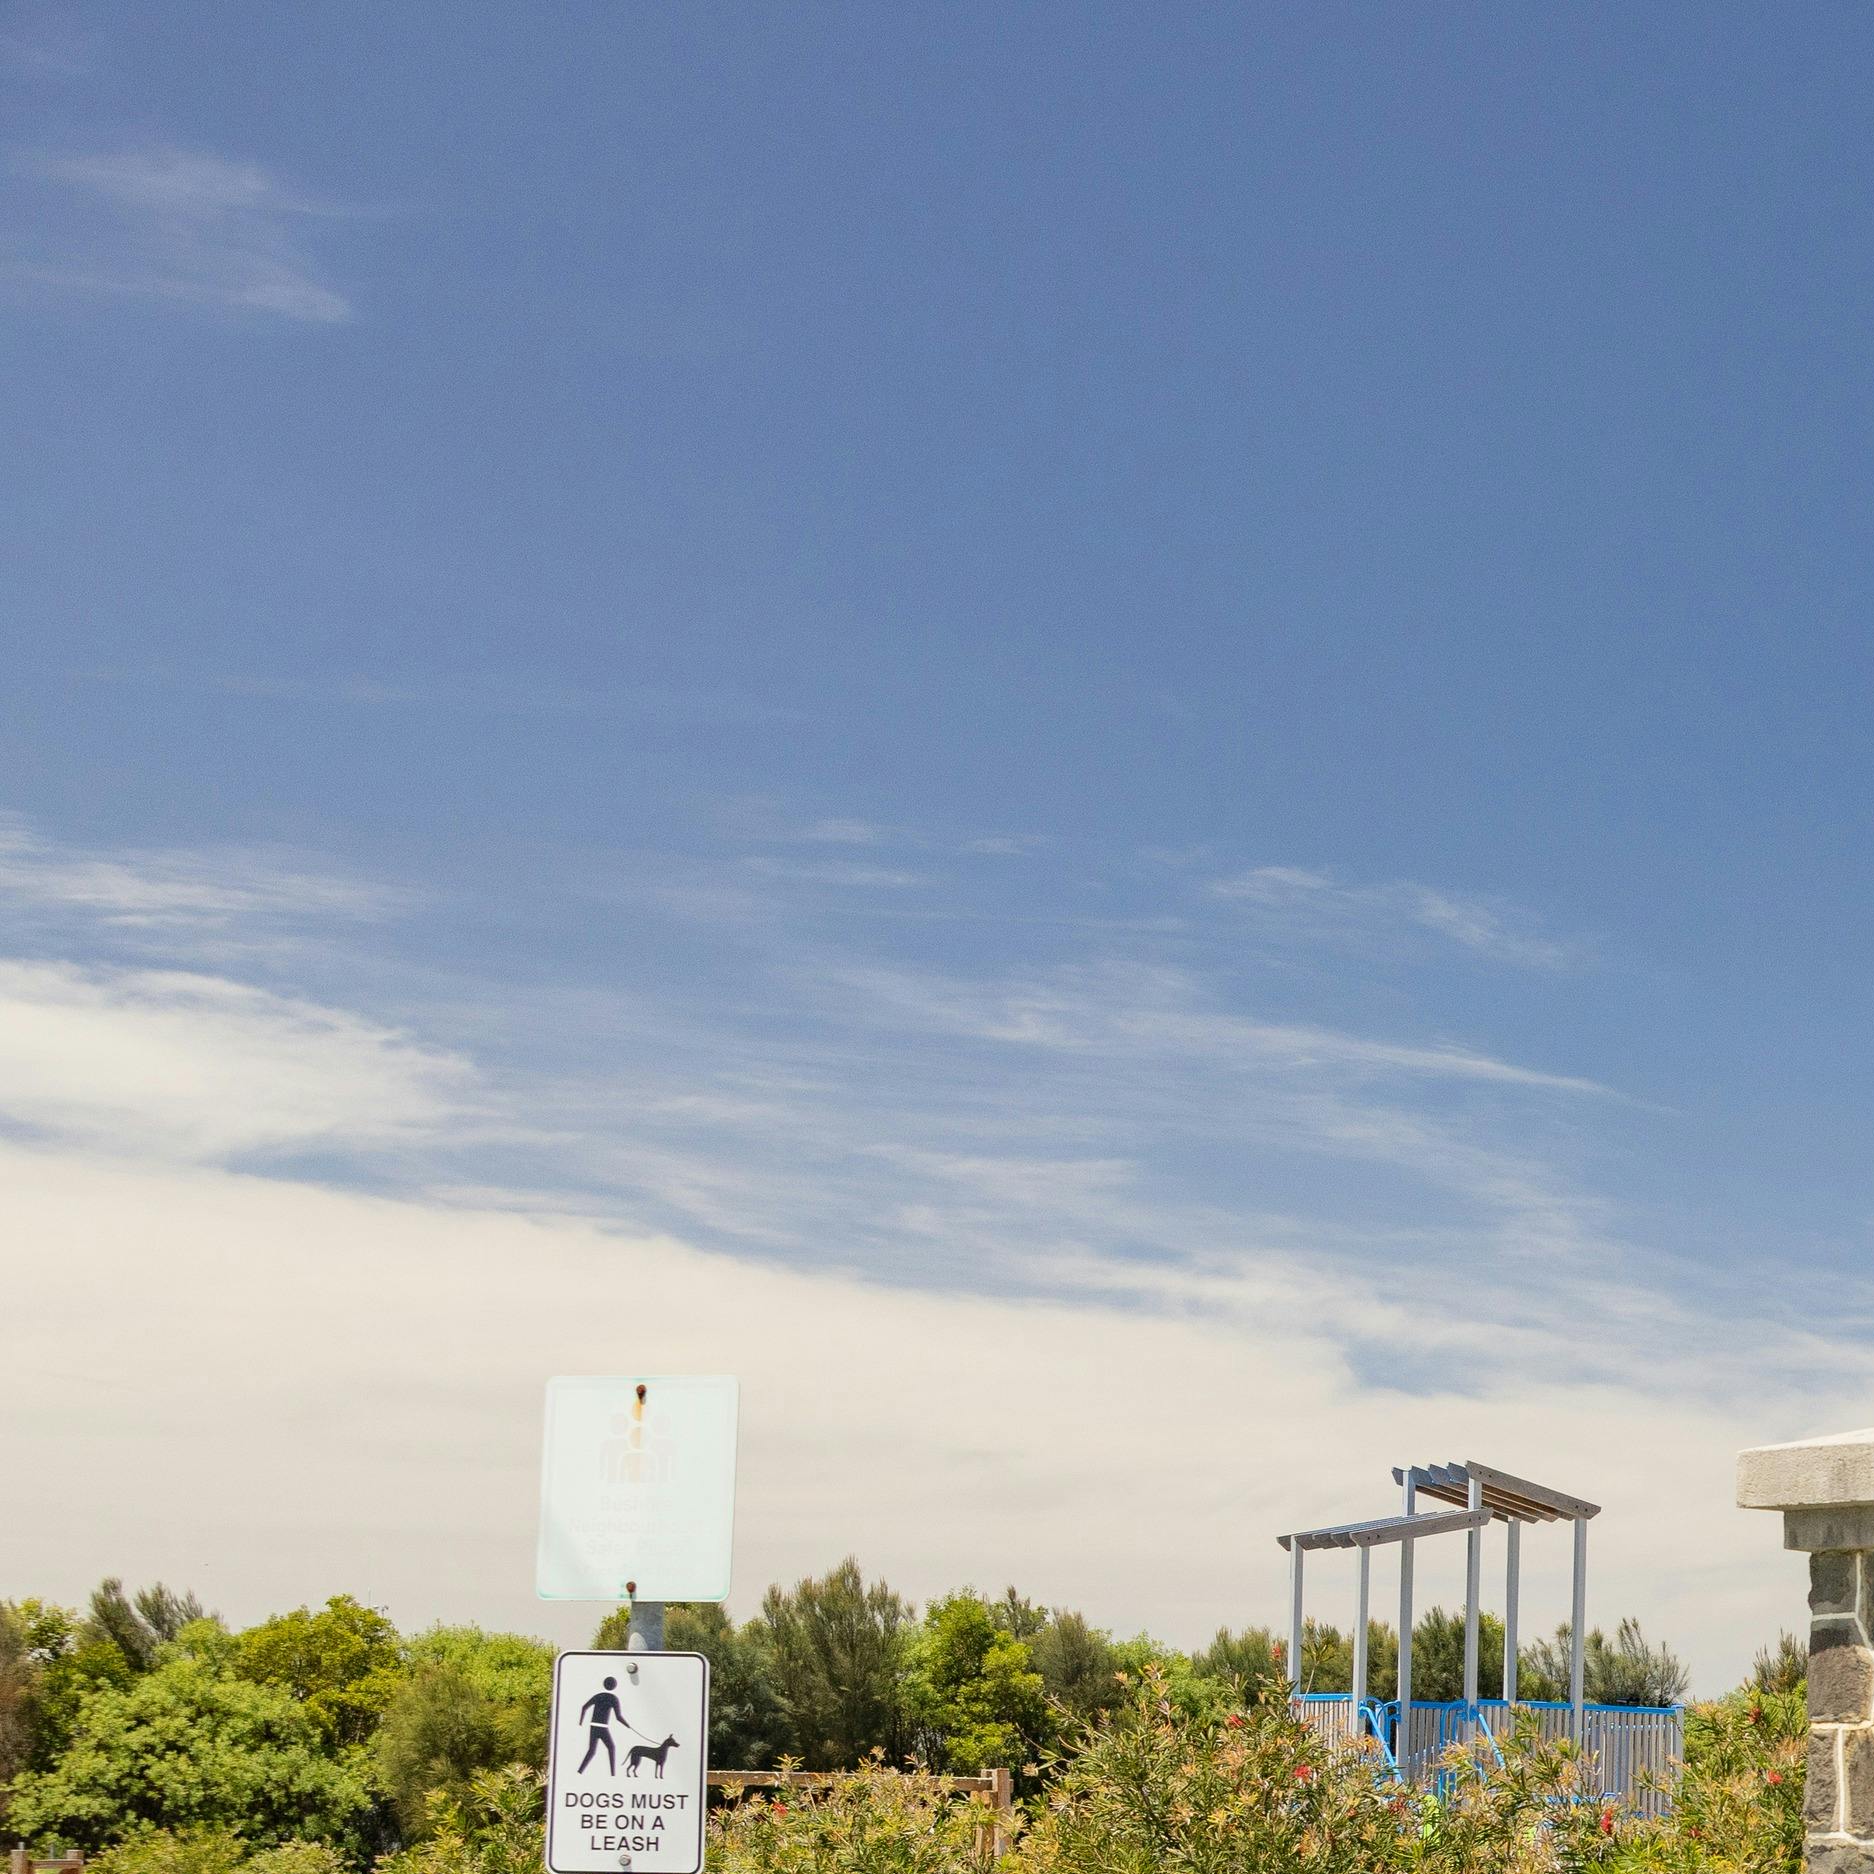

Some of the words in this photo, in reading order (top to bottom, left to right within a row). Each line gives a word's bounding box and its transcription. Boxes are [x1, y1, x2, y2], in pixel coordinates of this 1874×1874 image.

[565, 1792, 624, 1809] DOGS
[631, 1794, 689, 1810] MUST
[581, 1814, 608, 1829] BE
[615, 1814, 644, 1830] ON
[651, 1815, 665, 1831] A
[591, 1835, 659, 1852] LEASH
